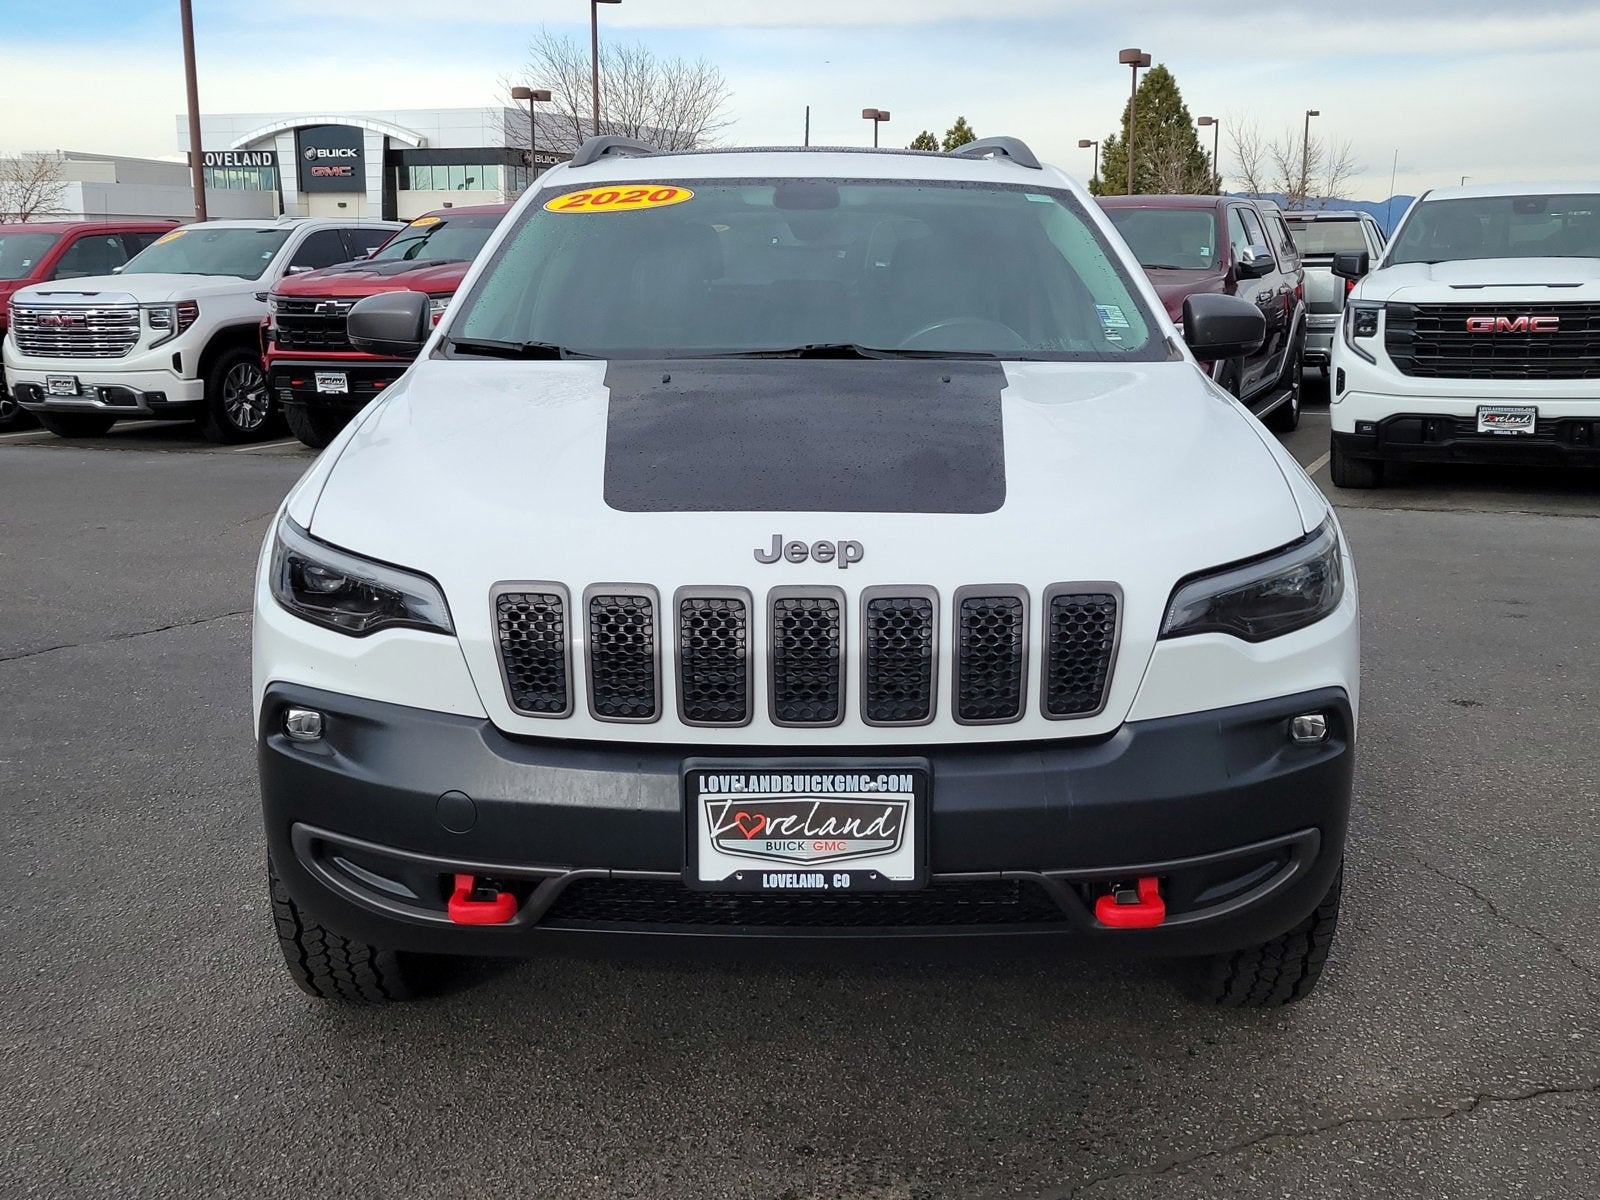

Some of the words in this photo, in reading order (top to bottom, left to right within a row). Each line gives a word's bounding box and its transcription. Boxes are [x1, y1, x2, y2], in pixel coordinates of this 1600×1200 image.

[317, 148, 357, 158] BUICK
[311, 166, 352, 177] GMC
[559, 189, 678, 209] 2020
[39, 315, 85, 327] GMC
[1466, 316, 1559, 332] GMC
[753, 534, 864, 569] Jeep
[699, 774, 913, 793] LOVELANDBUICKGMCCOM
[710, 799, 896, 840] Loveland
[766, 841, 805, 851] BUICK
[812, 841, 847, 851] GMC
[762, 873, 829, 890] LOVELAND,
[833, 873, 850, 888] CO
